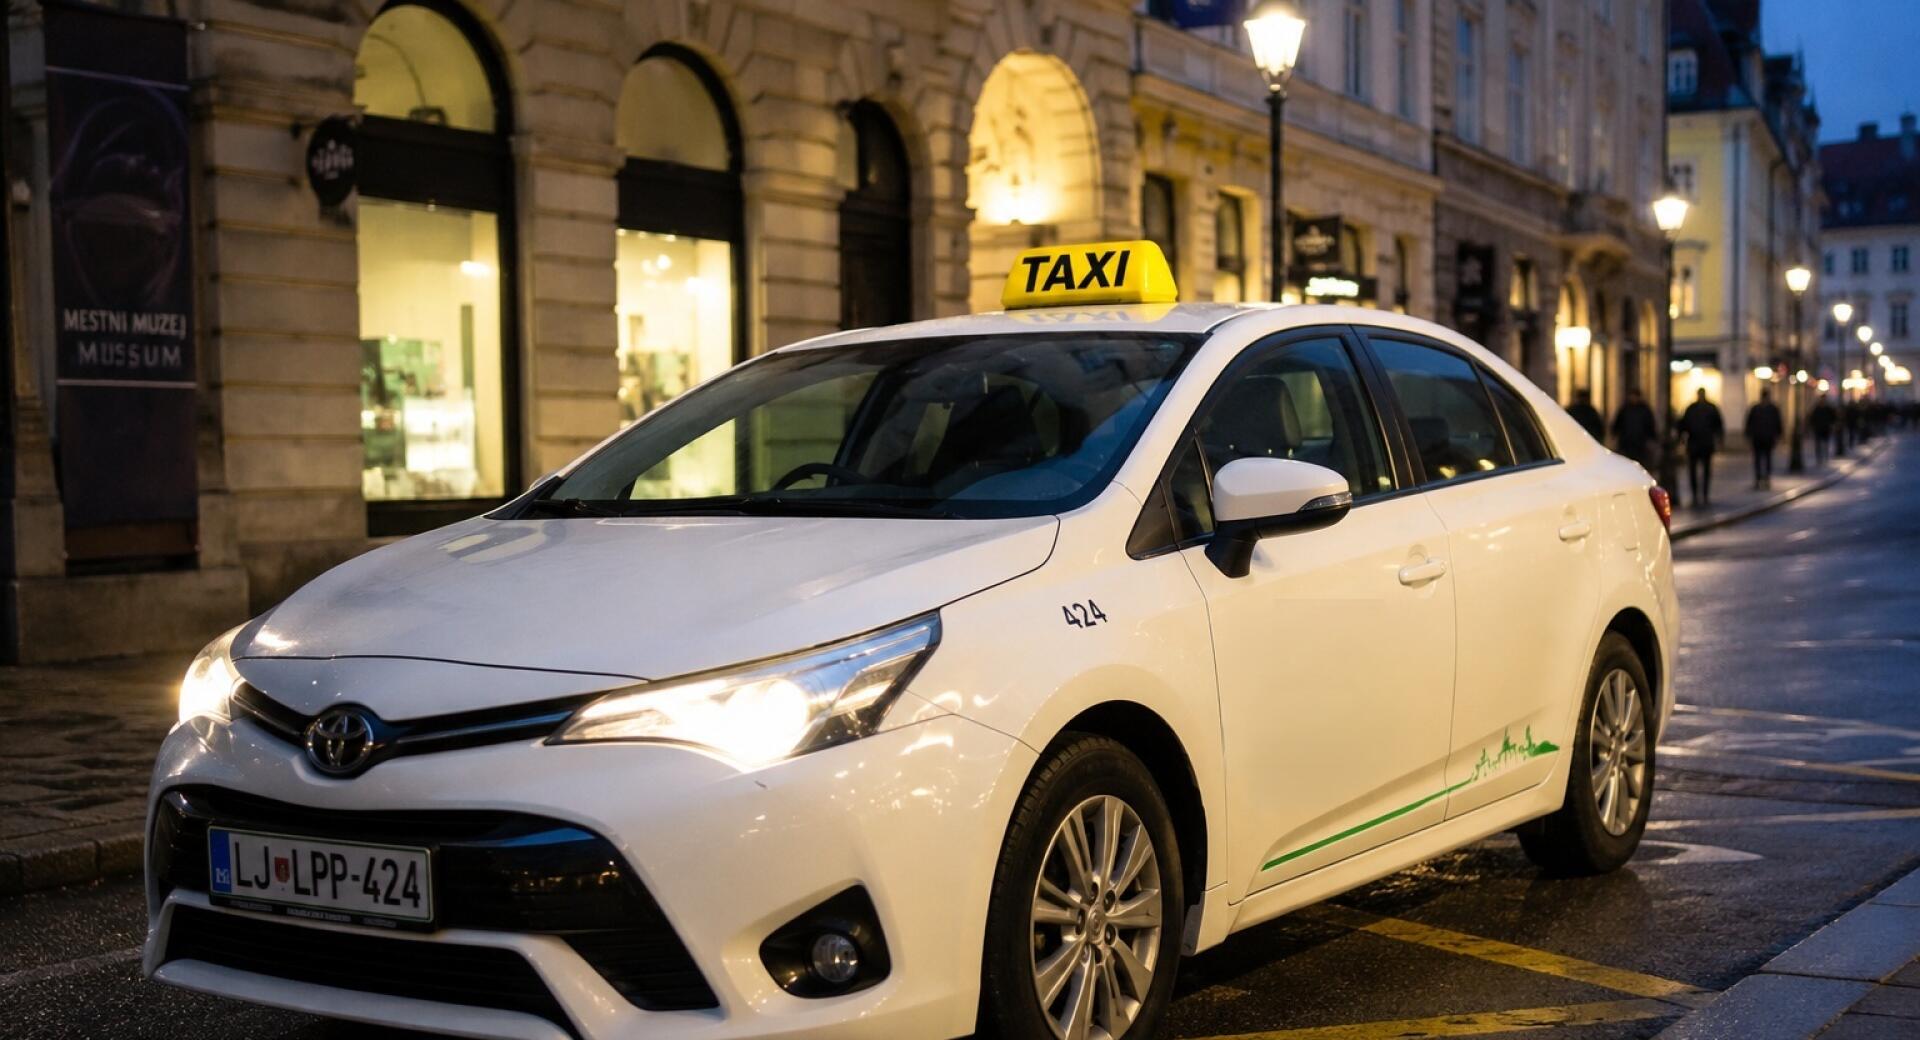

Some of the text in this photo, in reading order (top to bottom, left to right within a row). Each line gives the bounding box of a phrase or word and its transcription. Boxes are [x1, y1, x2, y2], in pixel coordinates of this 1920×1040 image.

[1022, 250, 1130, 292] TAXI
[63, 308, 187, 340] MESTNI MUZEJ
[1062, 600, 1107, 628] 424
[235, 842, 421, 908] LJ LPP-424
